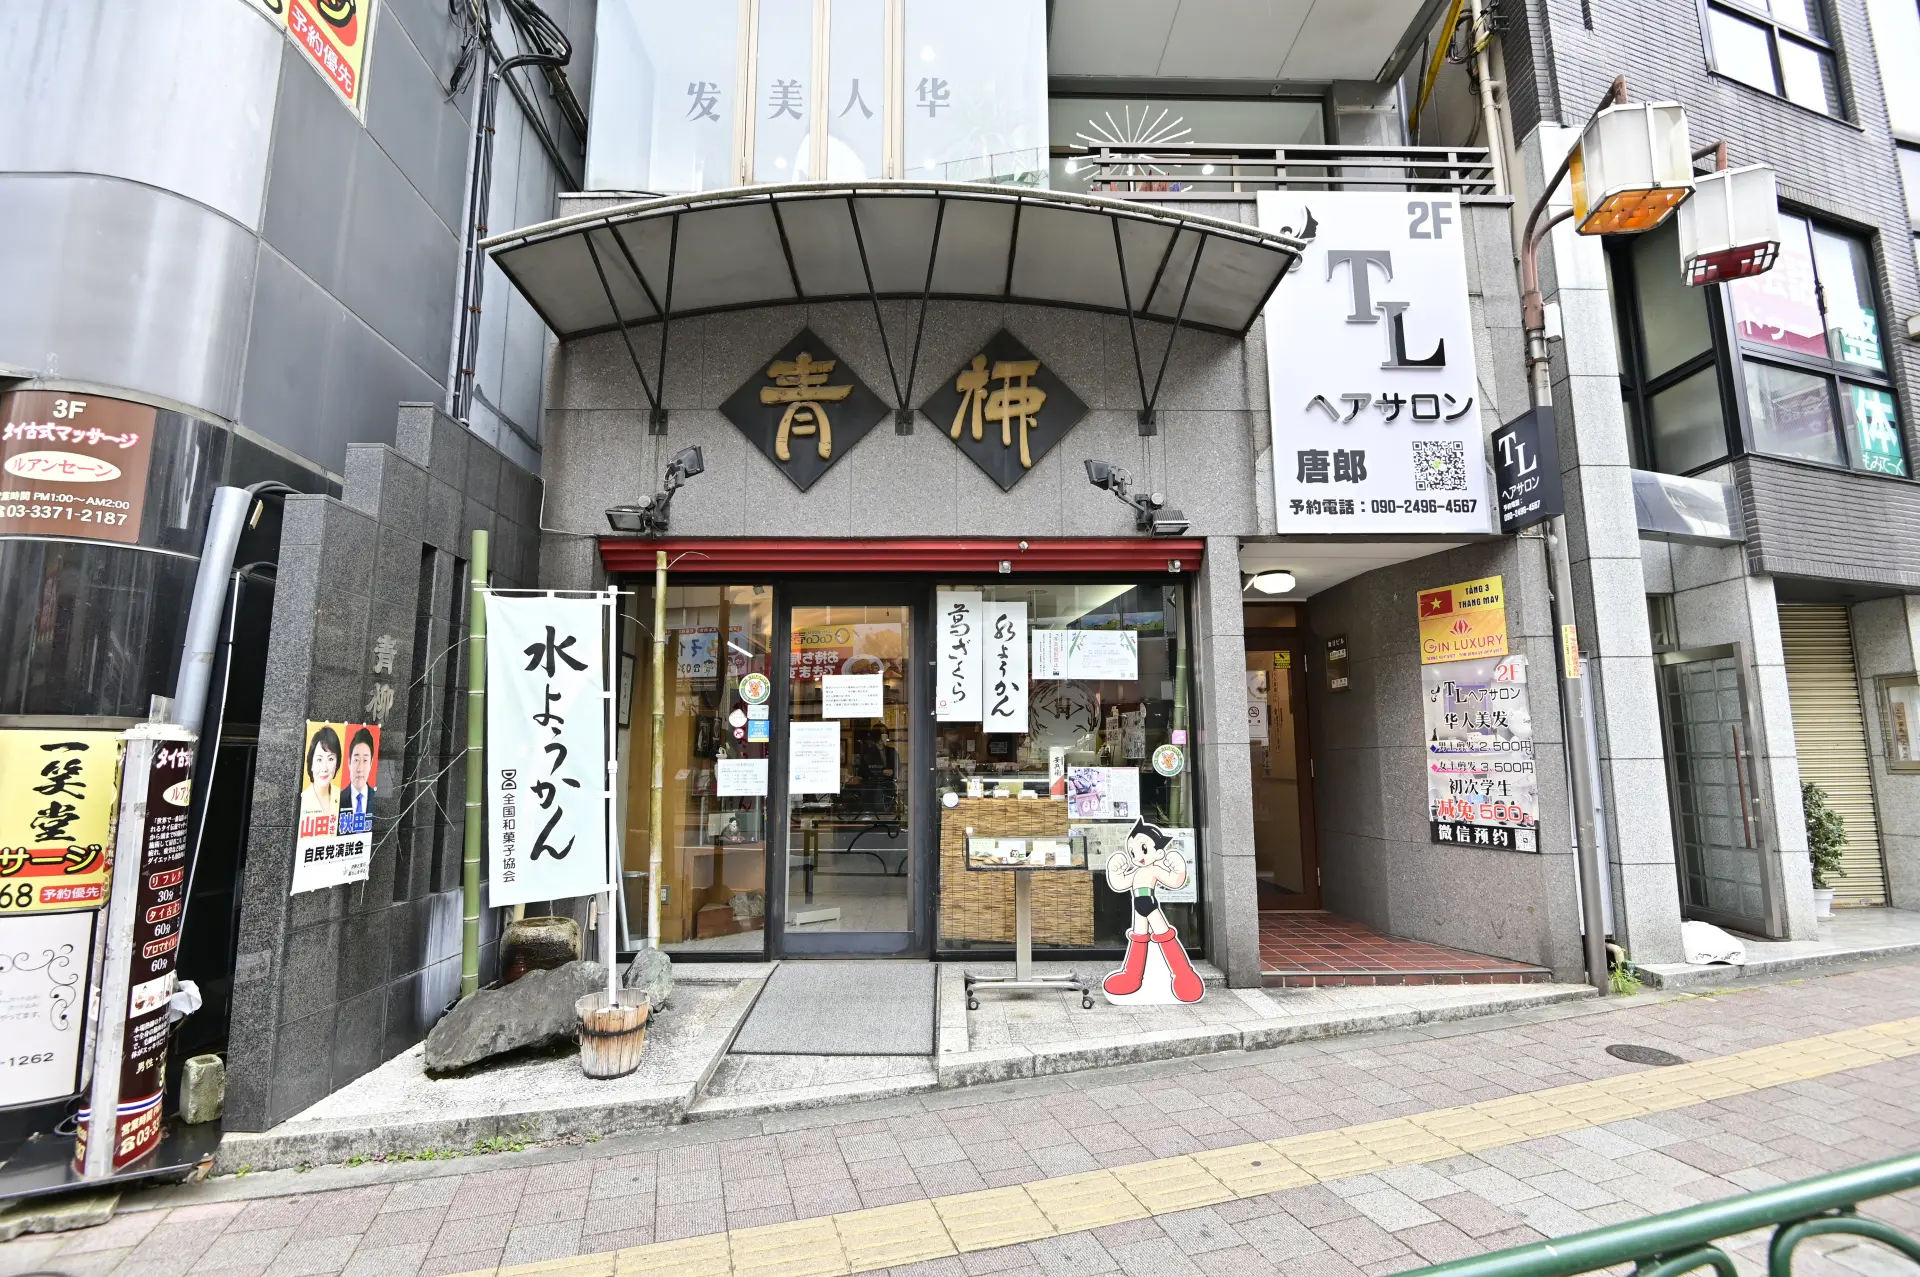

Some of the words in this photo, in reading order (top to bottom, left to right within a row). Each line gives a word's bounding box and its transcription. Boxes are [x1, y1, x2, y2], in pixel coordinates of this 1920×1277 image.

[291, 5, 352, 93] 予約優先
[1407, 201, 1453, 239] 2F
[53, 399, 87, 419] 3F
[1306, 393, 1473, 422] ヘアサロン
[2, 422, 139, 449] タイ古式マッサージ
[1498, 431, 1537, 477] TL
[13, 457, 113, 477] ルアンセーン
[1296, 449, 1368, 484] 唐郎
[1502, 476, 1539, 499] ヘアサロン
[6, 504, 128, 526] 03-3371-2187
[1484, 584, 1490, 592] 3
[1424, 638, 1450, 654] GIN
[1454, 634, 1504, 651] LUXURY
[990, 613, 1020, 718] 水ようかん
[1497, 663, 1520, 682] 2F
[366, 634, 398, 723] 青柳
[1444, 711, 1509, 730] 华人美发
[523, 625, 590, 861] 水ようかん
[30, 742, 90, 843] 一笑堂
[1449, 779, 1513, 797] 初次学生
[300, 816, 329, 838] 山田
[339, 812, 366, 834] 秋田
[1438, 824, 1509, 847] 微信预约
[502, 793, 516, 883] 全国和菓子協会
[304, 840, 364, 863] 自民党演説会
[42, 885, 100, 900] 予約優先
